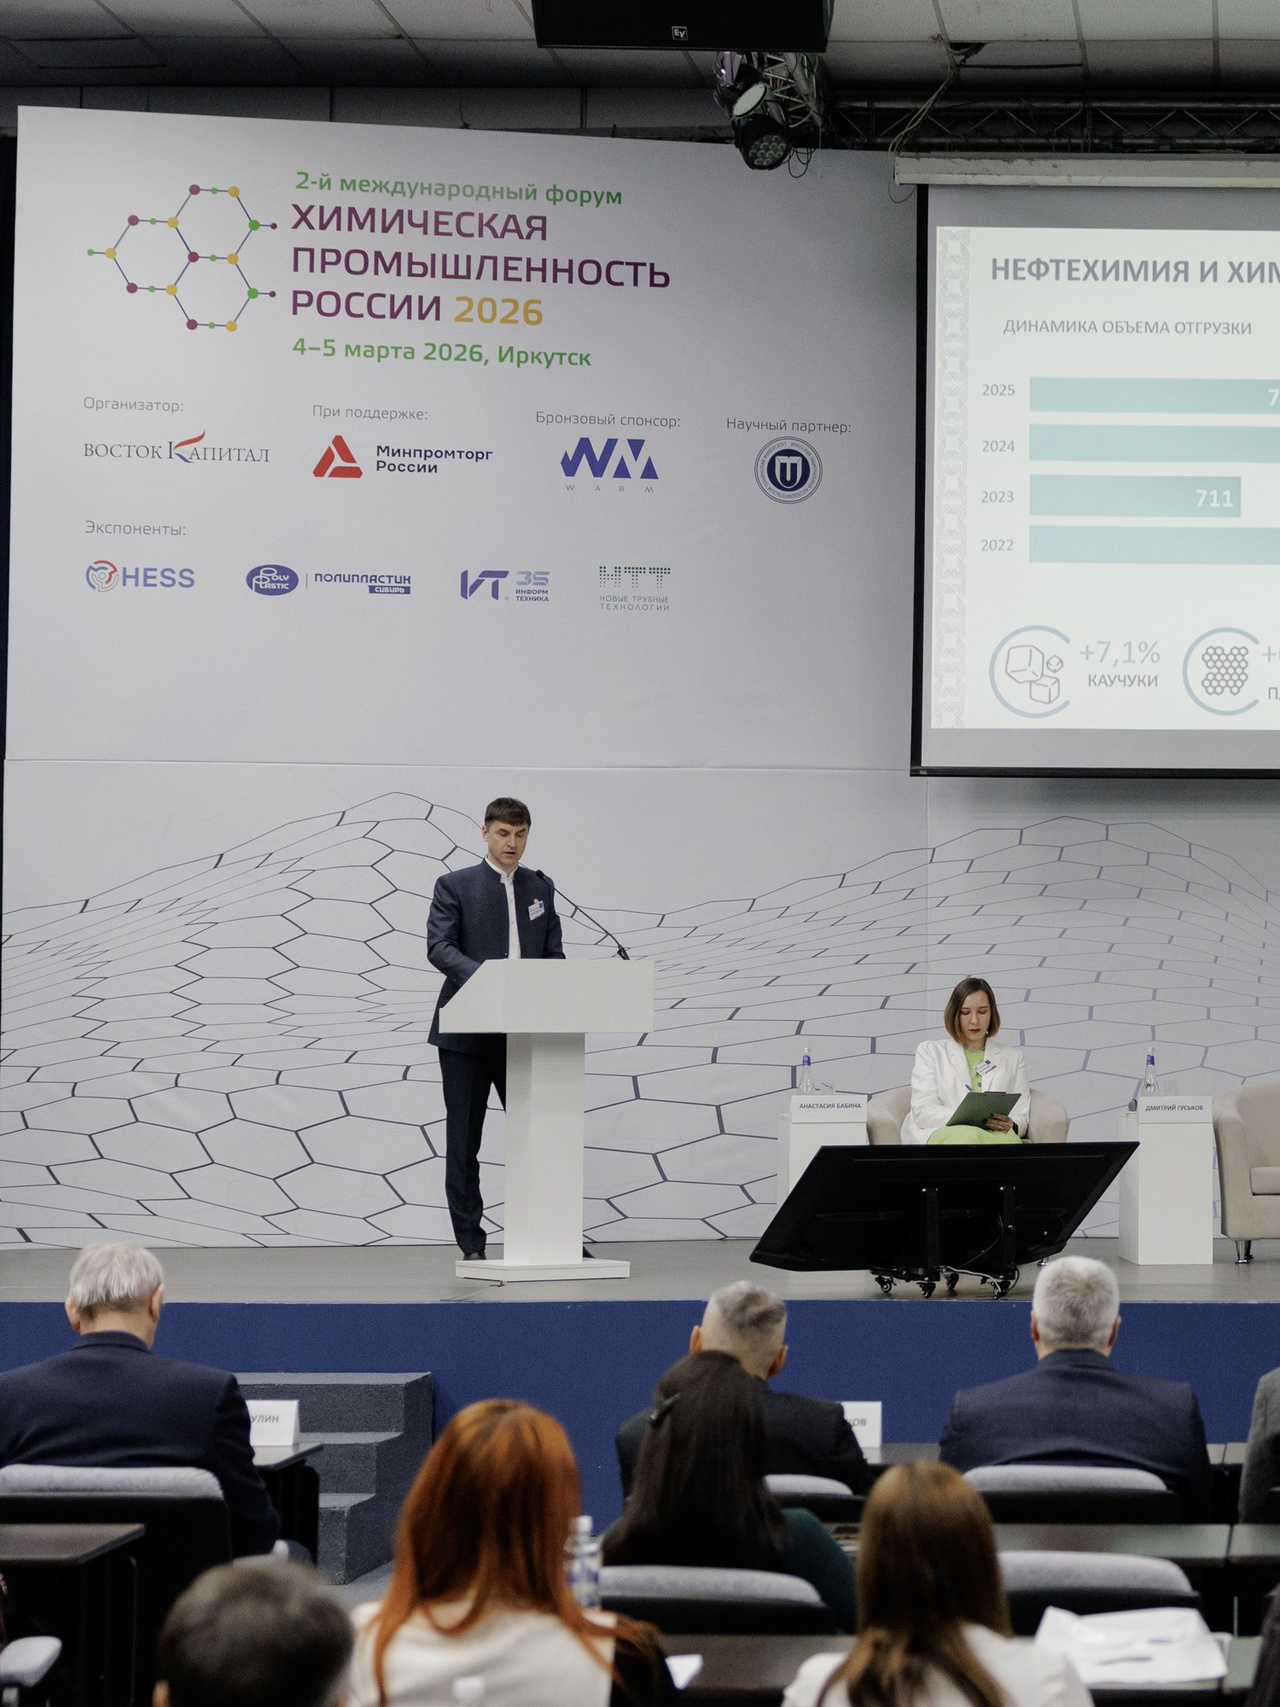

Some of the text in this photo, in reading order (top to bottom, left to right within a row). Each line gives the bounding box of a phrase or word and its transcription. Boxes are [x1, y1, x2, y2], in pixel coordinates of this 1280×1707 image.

[295, 172, 622, 208] 2-й международный форум
[291, 203, 547, 241] ХИМИЧЕСКАЯ
[292, 246, 671, 288] ПРОМЫШЛЕННОСТЬ
[991, 257, 1190, 283] НЕФТЕХИМИЯ
[1200, 260, 1218, 283] И
[291, 289, 543, 326] РОССИИ 2026
[1003, 319, 1252, 335] ДИНАМИКА ОБЪЕМА ОТГРУЗКИ
[345, 343, 415, 363] марта
[423, 343, 489, 366] 2026,
[499, 346, 591, 369] Иркутск
[982, 384, 1016, 397] 2025
[83, 396, 184, 415] Организатор:
[313, 404, 428, 421] При поддержке:
[536, 411, 681, 429] Бронзовый спонсор:
[726, 417, 852, 435] Научный партнер:
[83, 442, 163, 460] ВОСТОК
[376, 444, 493, 462] Минпромторг
[981, 440, 1016, 453] 2024
[376, 460, 438, 474] России
[981, 490, 1015, 503] 2023
[1195, 489, 1234, 508] 711
[85, 520, 187, 537] Экспоненты:
[980, 539, 1014, 552] 2022
[122, 567, 195, 588] HESS
[314, 573, 411, 584] ПОЛИПЛАСТИК
[374, 586, 405, 594] СИБИРЬ
[600, 603, 670, 611] ТЕХНОЛОГИИ
[1080, 640, 1161, 668] +7,1%
[1088, 674, 1159, 688] КАУЧУКИ
